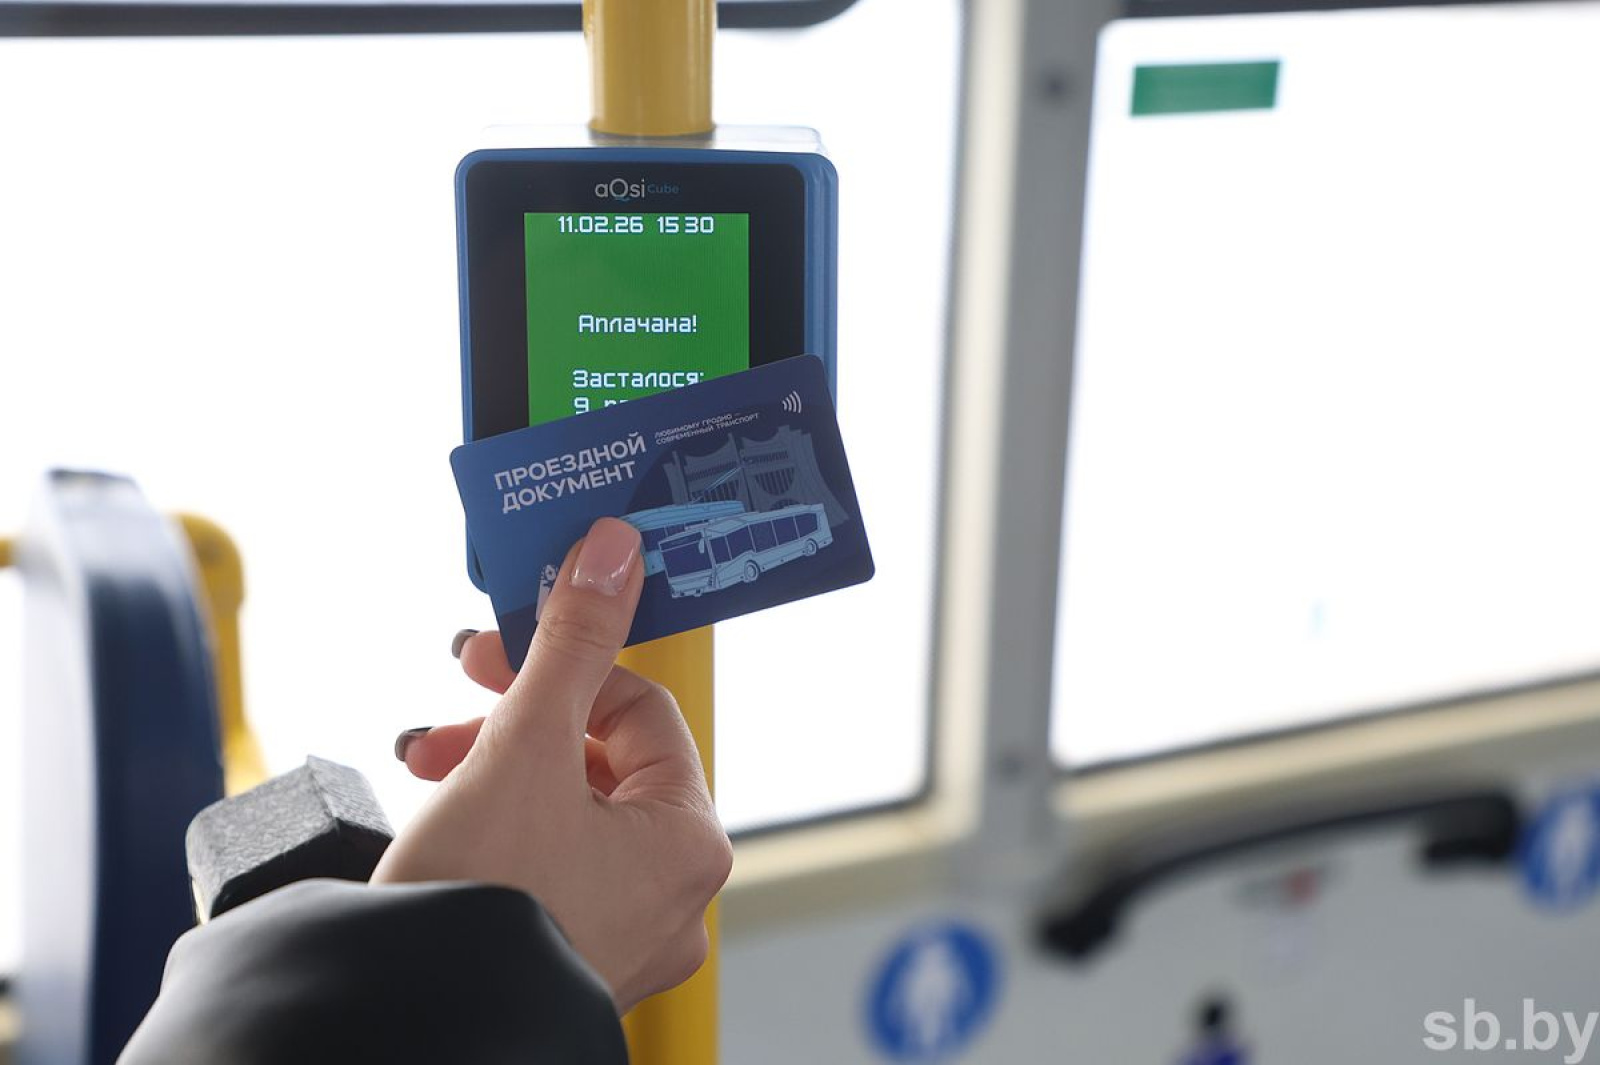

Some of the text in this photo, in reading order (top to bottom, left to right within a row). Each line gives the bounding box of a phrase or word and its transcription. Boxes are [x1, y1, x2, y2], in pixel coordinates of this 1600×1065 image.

[647, 183, 680, 193] Cube
[558, 215, 644, 233] 11.02.26
[578, 314, 697, 333] Аплачана!
[572, 369, 705, 388] Засталося:
[574, 397, 589, 415] 9
[655, 422, 700, 438] ЛЮБИМОМУ
[702, 413, 732, 426] ГРОДНО
[656, 412, 759, 445] СОВРЕМЕННЫЙ ТРАНСПОРТ
[494, 431, 647, 490] ПРОЕЗДНОЙ
[502, 460, 636, 514] ДОКУМЕНТ
